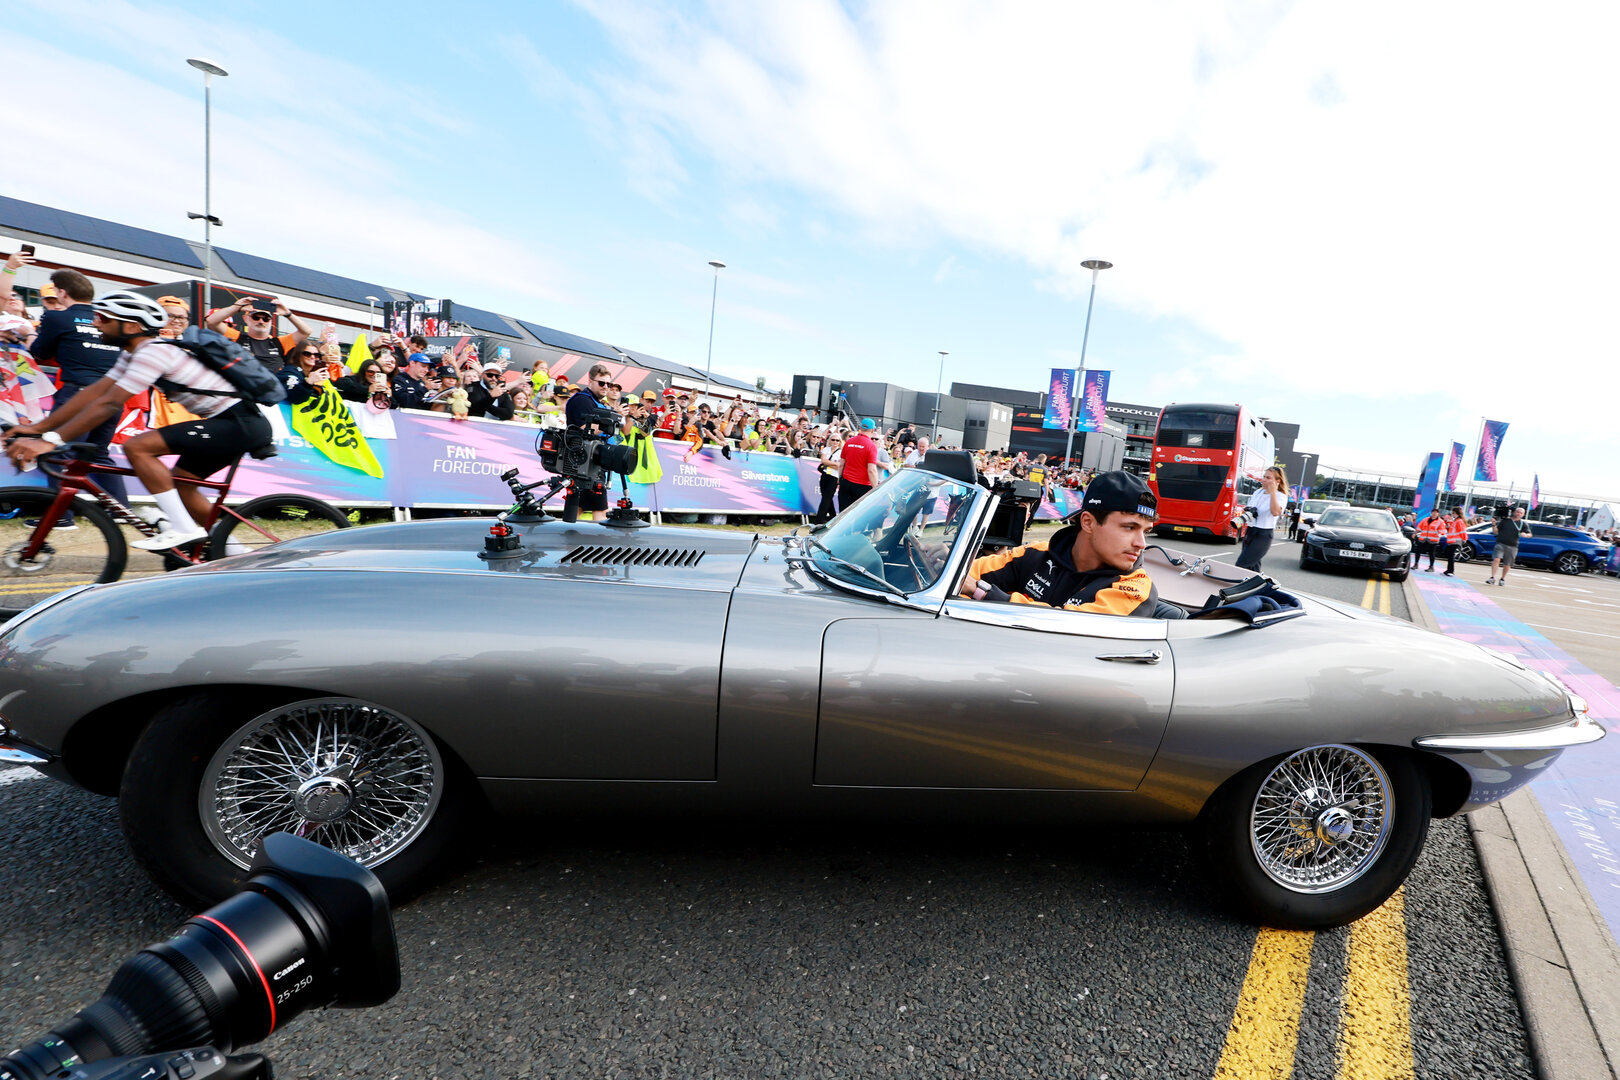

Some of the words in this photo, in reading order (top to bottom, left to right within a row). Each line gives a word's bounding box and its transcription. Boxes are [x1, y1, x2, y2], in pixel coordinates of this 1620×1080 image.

[424, 344, 447, 355] Store
[1058, 371, 1070, 413] FORECOURT
[1092, 373, 1105, 415] FORECOURT
[1051, 394, 1060, 408] FAN
[1085, 396, 1094, 410] FAN
[1105, 406, 1143, 415] ADDOCK
[1143, 410, 1160, 418] CLU
[446, 445, 476, 460] FAN
[679, 464, 697, 476] FAN
[741, 470, 790, 483] Silverstone
[672, 474, 722, 488] FORECOURT
[1026, 579, 1044, 596] DELL
[273, 957, 305, 981] Canon
[277, 975, 313, 1005] 25-250
